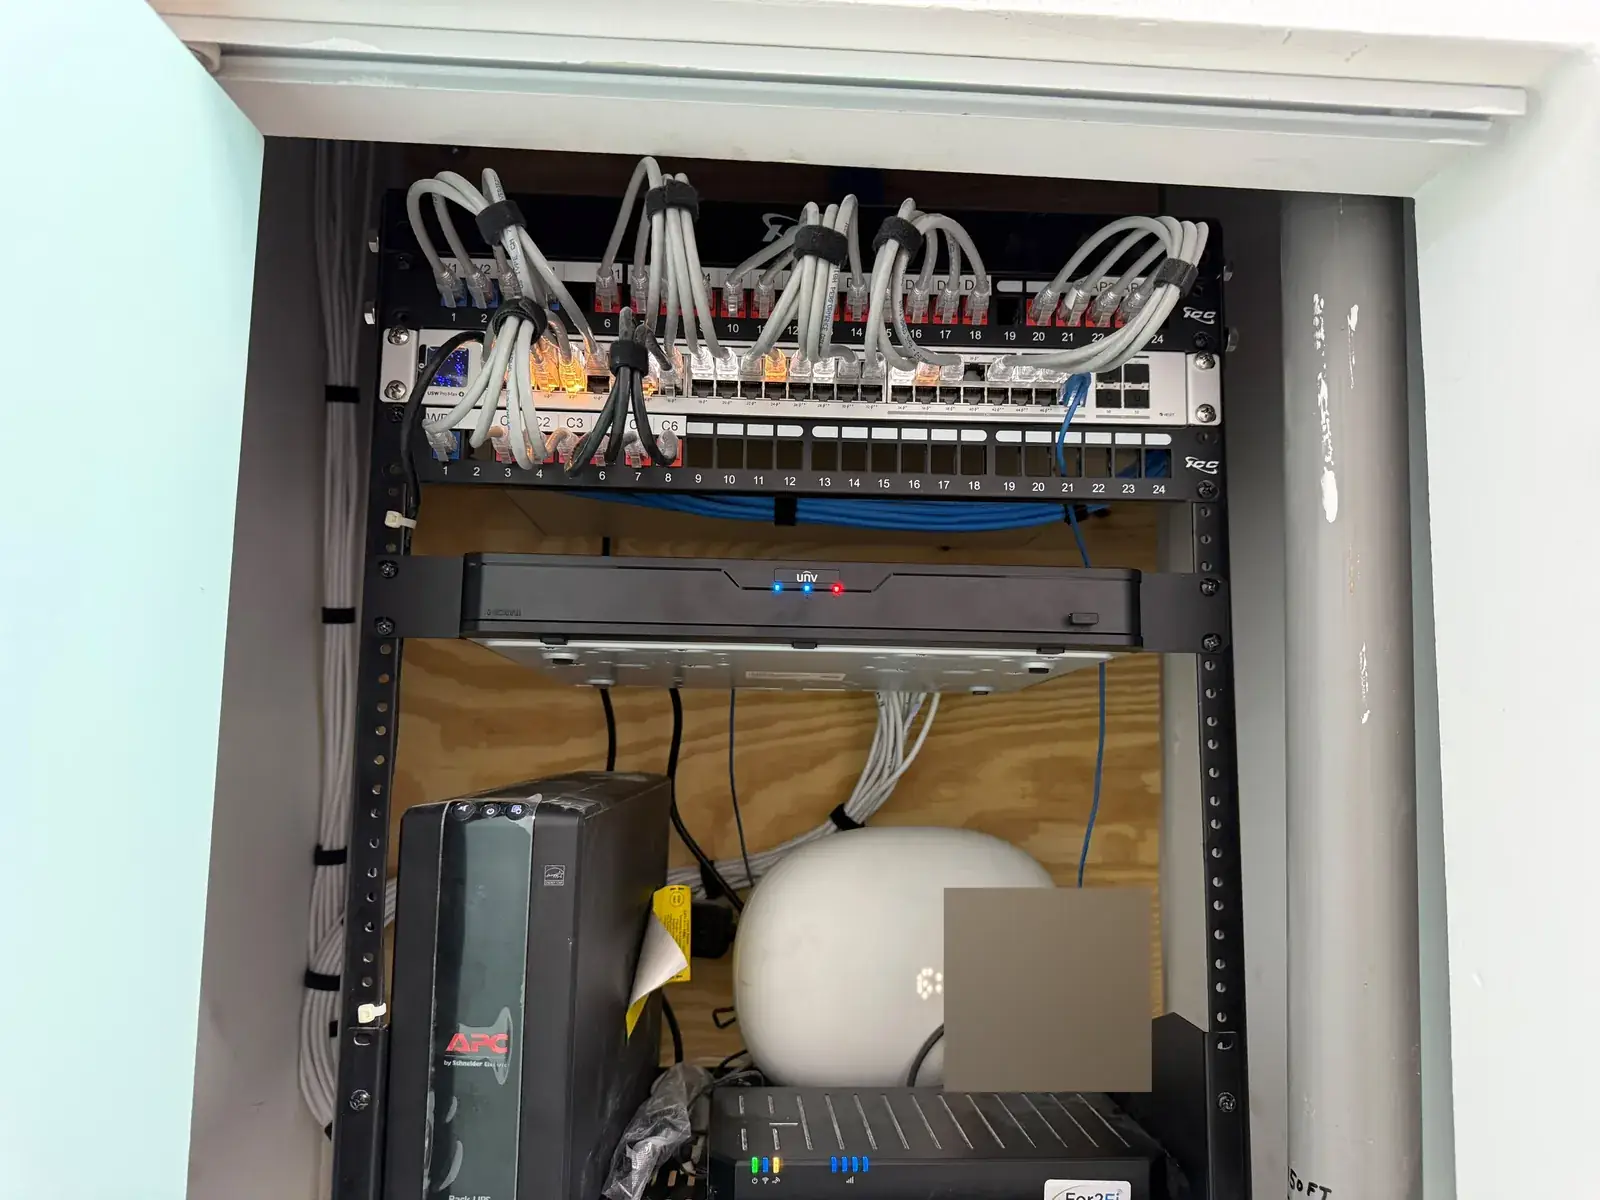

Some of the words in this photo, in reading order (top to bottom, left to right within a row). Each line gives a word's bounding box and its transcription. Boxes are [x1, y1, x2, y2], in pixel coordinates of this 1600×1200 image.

[451, 312, 456, 322] 1
[480, 313, 488, 324] 2
[603, 318, 611, 329] 6
[727, 323, 740, 333] 10
[786, 324, 800, 336] 12
[850, 327, 863, 337] 14
[909, 328, 923, 340] 16
[939, 329, 952, 339] 17
[969, 330, 982, 340] 18
[1004, 331, 1016, 341] 19
[1032, 331, 1046, 342] 20
[1061, 332, 1074, 342] 21
[1149, 333, 1165, 345] 24
[537, 416, 551, 428] C2
[566, 417, 584, 428] C3
[661, 420, 679, 431] C6
[442, 465, 448, 475] 1
[473, 466, 481, 477] 2
[504, 467, 512, 478] 3
[535, 469, 543, 479] 4
[598, 470, 606, 481] 6
[635, 471, 642, 481] 7
[664, 472, 672, 483] 8
[695, 473, 702, 484] 9
[723, 474, 736, 485] 10
[753, 475, 764, 485] 11
[784, 476, 796, 486] 12
[818, 477, 831, 487] 13
[848, 478, 861, 488] 14
[878, 478, 890, 489] 15
[908, 479, 921, 489] 16
[938, 480, 950, 490] 17
[968, 480, 981, 491] 18
[1003, 481, 1016, 492] 19
[1032, 482, 1045, 492] 20
[1061, 482, 1074, 493] 21
[1092, 483, 1105, 493] 22
[1122, 483, 1136, 494] 23
[1152, 484, 1166, 494] 24
[445, 1033, 508, 1053] APC
